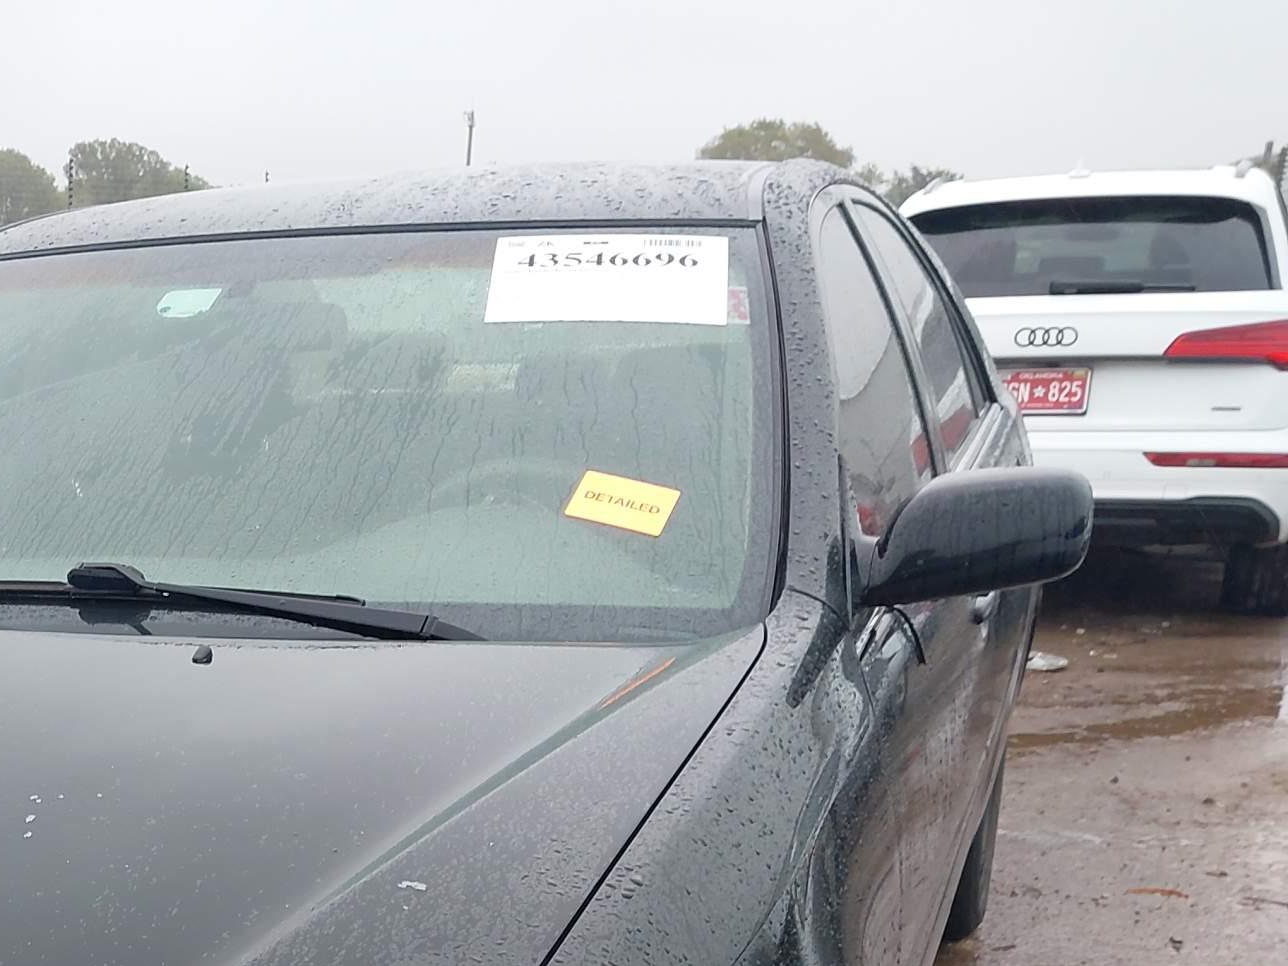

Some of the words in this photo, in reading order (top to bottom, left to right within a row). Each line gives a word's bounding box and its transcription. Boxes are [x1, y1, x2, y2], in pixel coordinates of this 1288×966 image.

[517, 251, 699, 267] 43546696
[1048, 381, 1082, 402] 825
[583, 489, 661, 514] DETAILED
